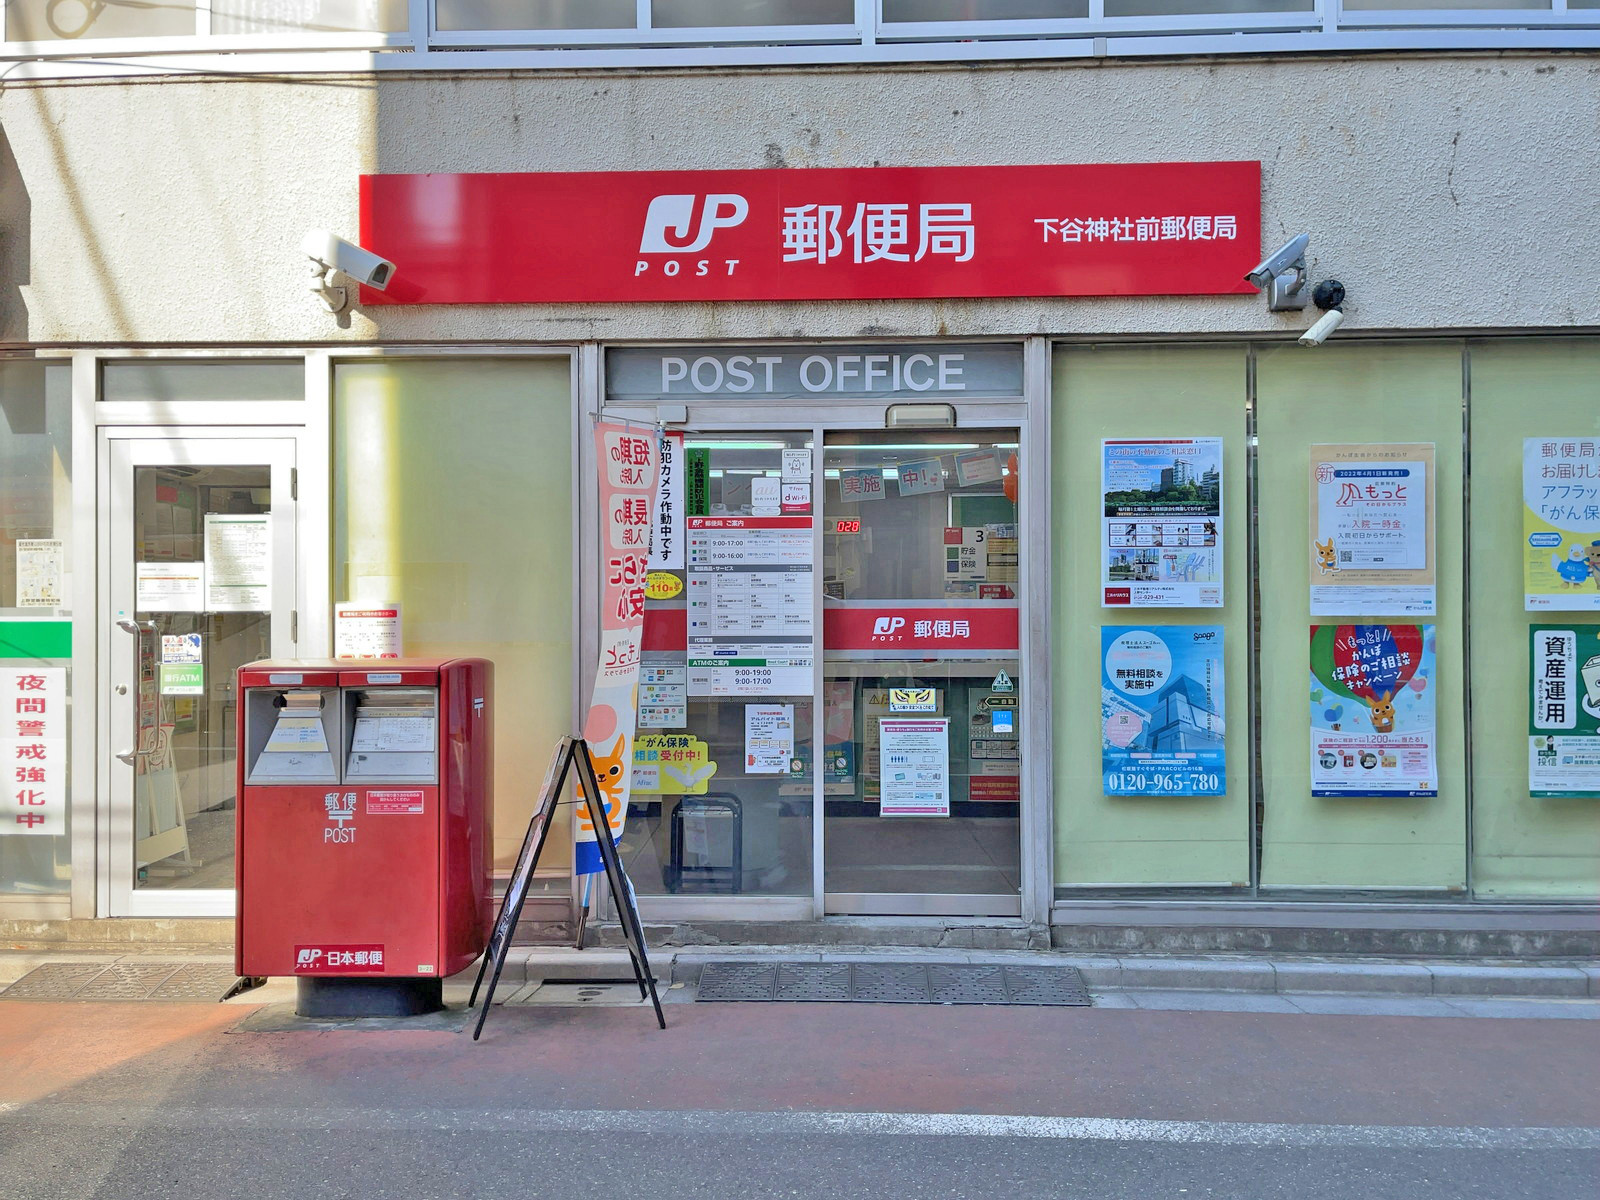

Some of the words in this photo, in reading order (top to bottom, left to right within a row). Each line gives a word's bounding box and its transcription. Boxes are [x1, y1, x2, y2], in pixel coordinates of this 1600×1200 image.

[638, 193, 748, 254] JP
[1033, 215, 1238, 243] 下谷神社前郵便局
[782, 202, 975, 264] 郵便局
[635, 259, 740, 277] POST
[661, 356, 783, 395] POST
[800, 353, 966, 392] OFFICE
[903, 469, 928, 488] 中!
[1318, 467, 1333, 482] 新
[844, 475, 881, 494] 実施
[1365, 484, 1407, 499] もっと
[660, 439, 672, 561] 防犯カメラ作動中です
[836, 521, 860, 533] 028
[975, 530, 984, 543] 3
[873, 617, 906, 635] JP
[913, 620, 970, 639] 郵便局
[1352, 644, 1381, 661] かんぽ
[1116, 669, 1164, 679] 無料相談を
[1331, 652, 1411, 681] 保険のご相談
[1124, 680, 1154, 690] 実施中
[1346, 671, 1403, 691] キャンペーン
[1545, 636, 1566, 723] 資産運用
[15, 674, 48, 829] 夜間警戒強化中
[1108, 774, 1219, 791] 0120-965-780
[324, 792, 357, 811] 郵便
[324, 827, 357, 843] POST
[297, 949, 322, 963] JP
[328, 950, 383, 966] 日本郵便
